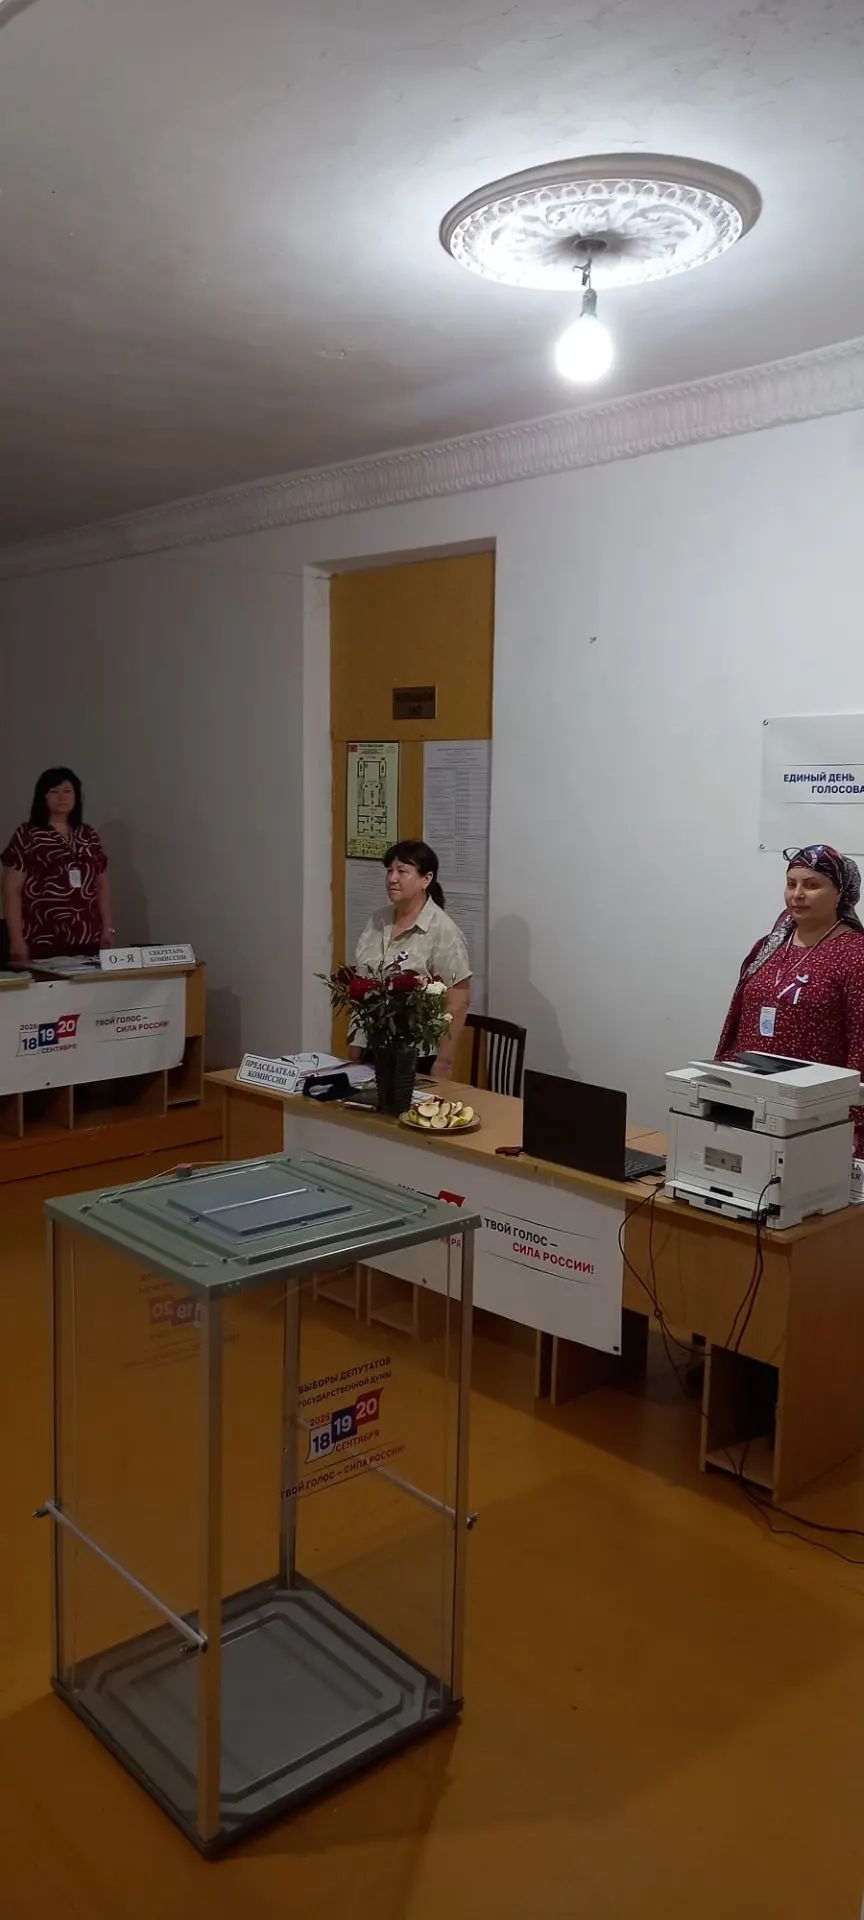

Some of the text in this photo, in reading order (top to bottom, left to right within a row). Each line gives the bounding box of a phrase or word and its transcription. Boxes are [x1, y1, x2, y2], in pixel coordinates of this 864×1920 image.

[783, 772, 855, 783] ЕДИНЫЙ ДЕНЬ
[96, 1016, 115, 1027] ТВОЙ
[116, 1014, 141, 1024] ГОЛОС
[116, 1025, 137, 1033] СИЛА
[22, 1020, 75, 1050] 18 19 20
[245, 1059, 297, 1077] ПРЕДСЕДАТЕЛЬ
[247, 1070, 287, 1086] КОМИССИИ
[485, 1218, 511, 1235] ТВОЙ
[513, 1227, 548, 1246] ГОЛОС
[512, 1242, 595, 1274] СИЛА РОССИИ!
[297, 1370, 392, 1408] ГОСУДАРСТВЕННОЙ ДУМЫ
[298, 1356, 391, 1394] ВЫБОРЫ ДЕПУТАТОВ
[312, 1397, 377, 1453] 18 19 20
[335, 1429, 380, 1452] СЕНТЯБРЯ
[280, 1483, 305, 1500] ТВОЙ
[305, 1470, 335, 1489] ГОЛОС
[344, 1459, 368, 1474] СИЛА
